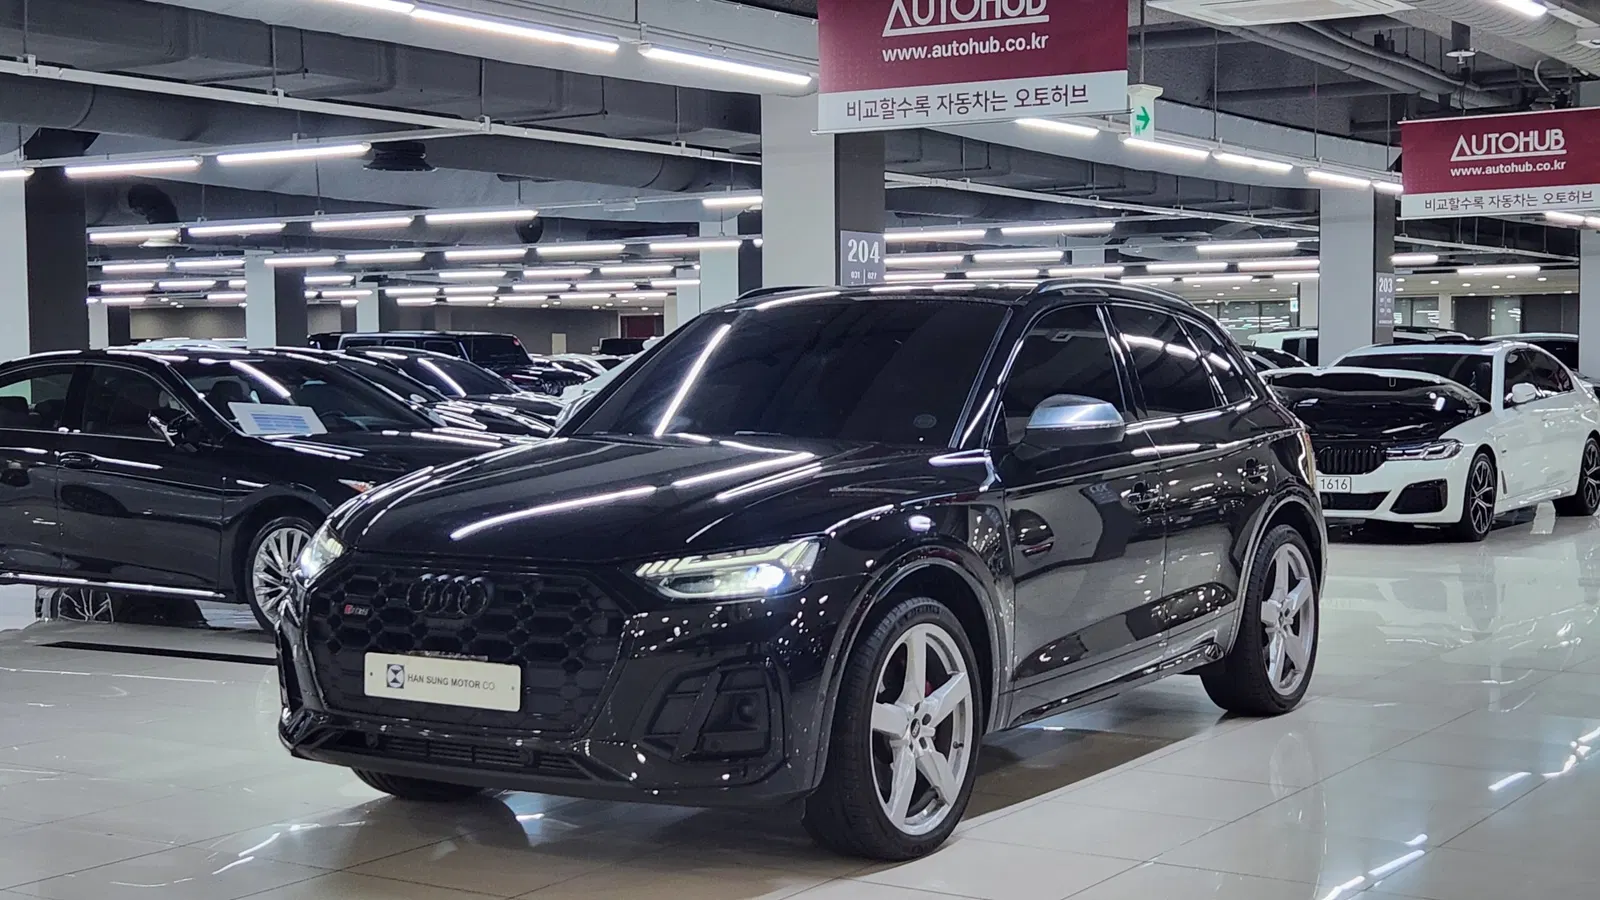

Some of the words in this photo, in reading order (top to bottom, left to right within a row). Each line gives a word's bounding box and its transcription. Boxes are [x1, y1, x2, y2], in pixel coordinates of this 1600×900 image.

[882, 32, 1049, 62] www.autohub.co.kr
[847, 94, 931, 120] 비교할수록
[936, 90, 1009, 116] 자동차는
[1014, 84, 1090, 108] 오토허브
[1450, 128, 1567, 162] AUTOHUB
[1450, 160, 1567, 177] www.autohub.co.kr
[1424, 195, 1485, 212] 비교할수록
[1488, 193, 1538, 208] 자동차는
[1542, 190, 1594, 206] 오토허브
[848, 239, 880, 263] 204
[1379, 277, 1393, 293] 203
[1321, 478, 1348, 490] 1616
[407, 674, 424, 684] HAN
[426, 676, 449, 687] SUNG
[450, 678, 481, 690] MOTOR
[482, 681, 496, 691] CO
